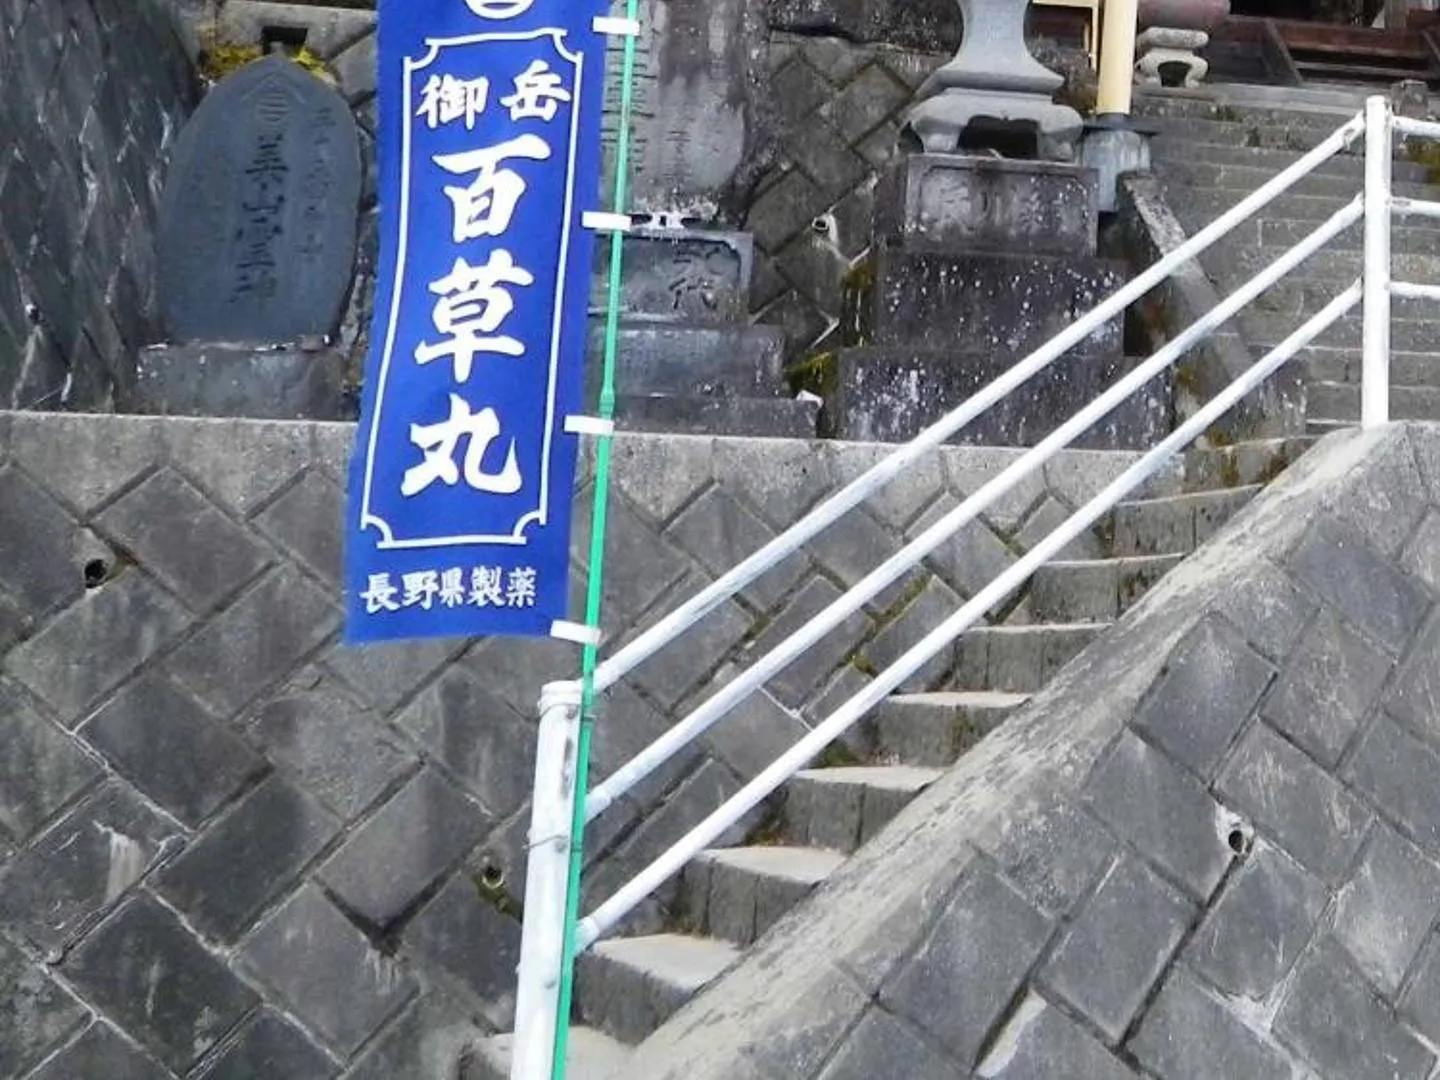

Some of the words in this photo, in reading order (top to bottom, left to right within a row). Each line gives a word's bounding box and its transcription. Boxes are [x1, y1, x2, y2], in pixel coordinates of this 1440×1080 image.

[416, 59, 571, 131] 御岳
[401, 133, 552, 497] 百草丸
[359, 566, 538, 613] 長野県製薬
